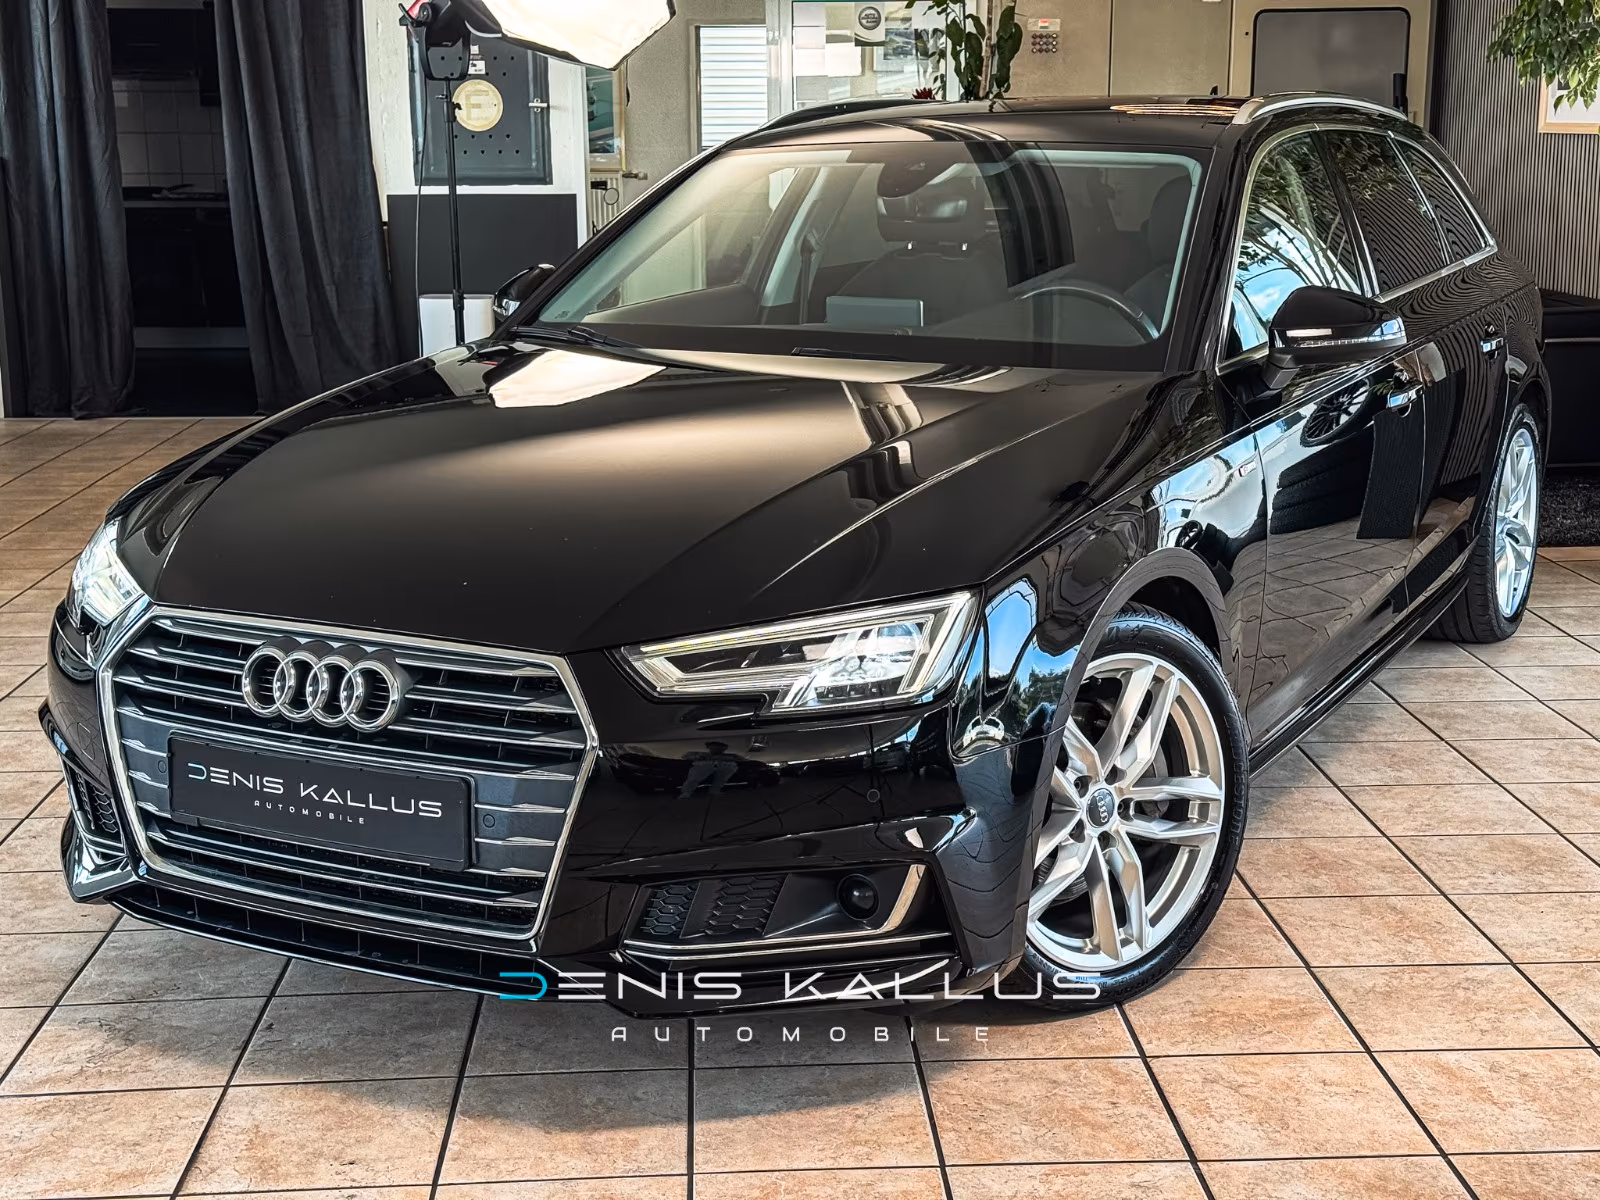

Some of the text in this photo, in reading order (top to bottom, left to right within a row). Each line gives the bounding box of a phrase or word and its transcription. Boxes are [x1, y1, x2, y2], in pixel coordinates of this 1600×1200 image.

[187, 762, 443, 818] DENIS KALLUS
[253, 799, 366, 825] AUTOMOBILE
